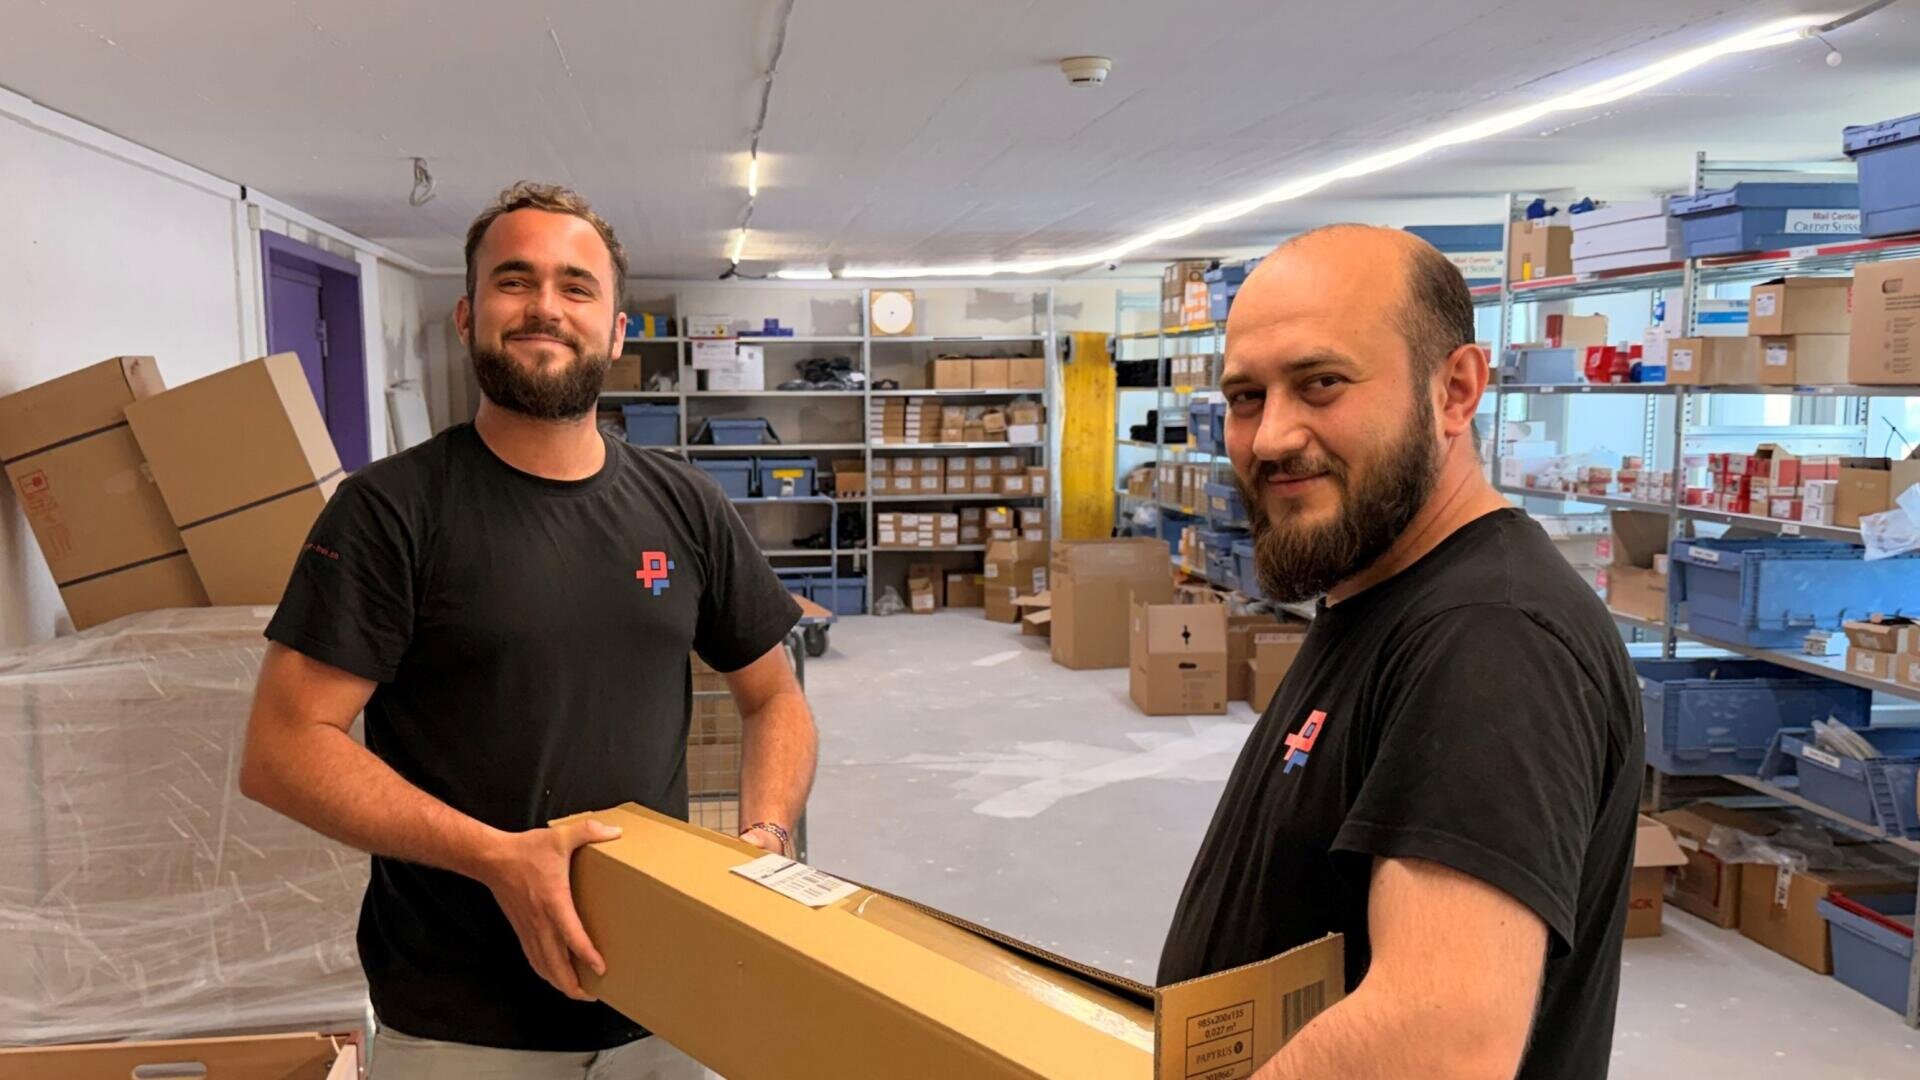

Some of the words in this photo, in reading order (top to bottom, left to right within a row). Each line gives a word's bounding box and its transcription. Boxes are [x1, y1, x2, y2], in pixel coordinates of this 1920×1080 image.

[1813, 212, 1829, 220] Mail
[1832, 212, 1858, 220] Center
[1794, 221, 1830, 232] CREDIT
[1832, 221, 1861, 232] SUISS
[1195, 1044, 1233, 1065] PAPYRUS
